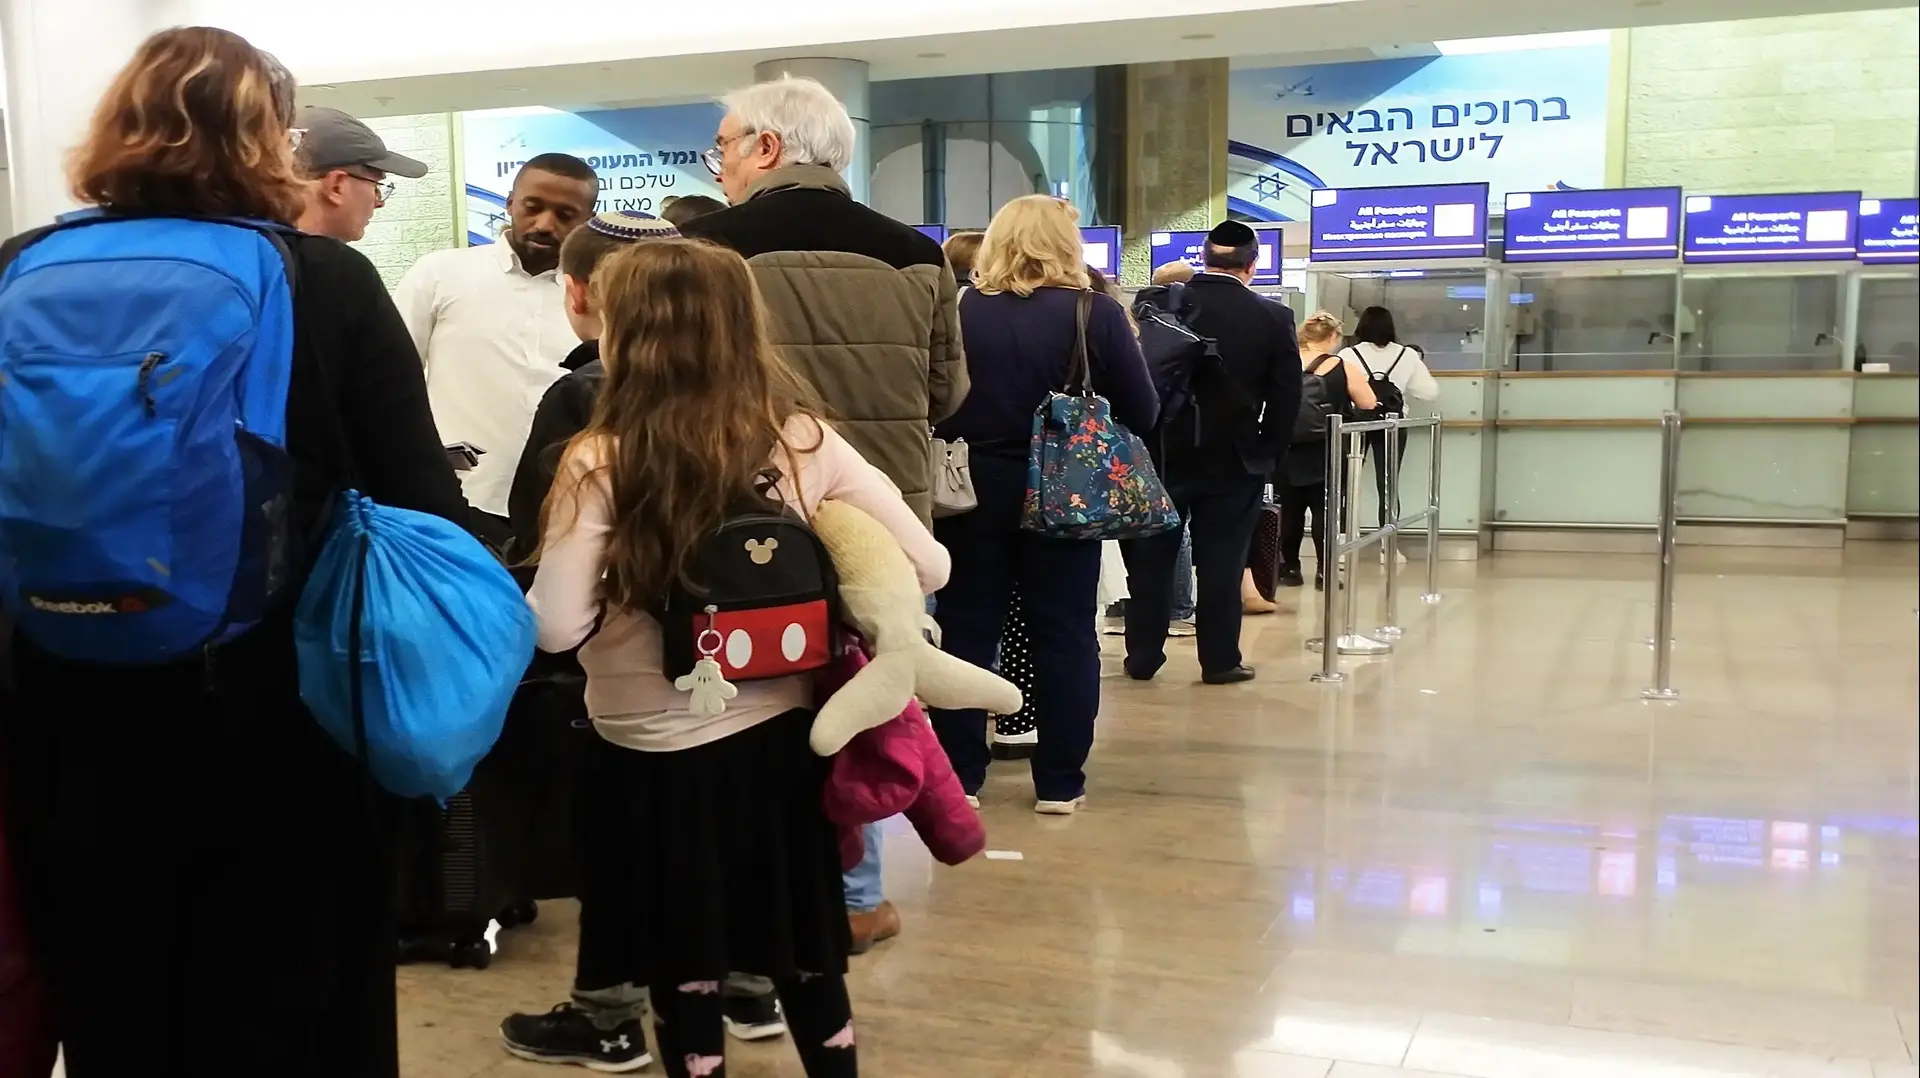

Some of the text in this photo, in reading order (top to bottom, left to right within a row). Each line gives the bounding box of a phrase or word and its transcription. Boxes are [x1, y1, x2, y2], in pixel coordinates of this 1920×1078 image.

[1286, 97, 1570, 138] ברוכים הבאים
[658, 150, 698, 165] נמל
[1345, 133, 1503, 167] לישראל
[579, 153, 653, 170] התעופ
[620, 174, 675, 190] שלכם
[614, 197, 652, 211] מאז
[30, 596, 118, 614] Reebok
